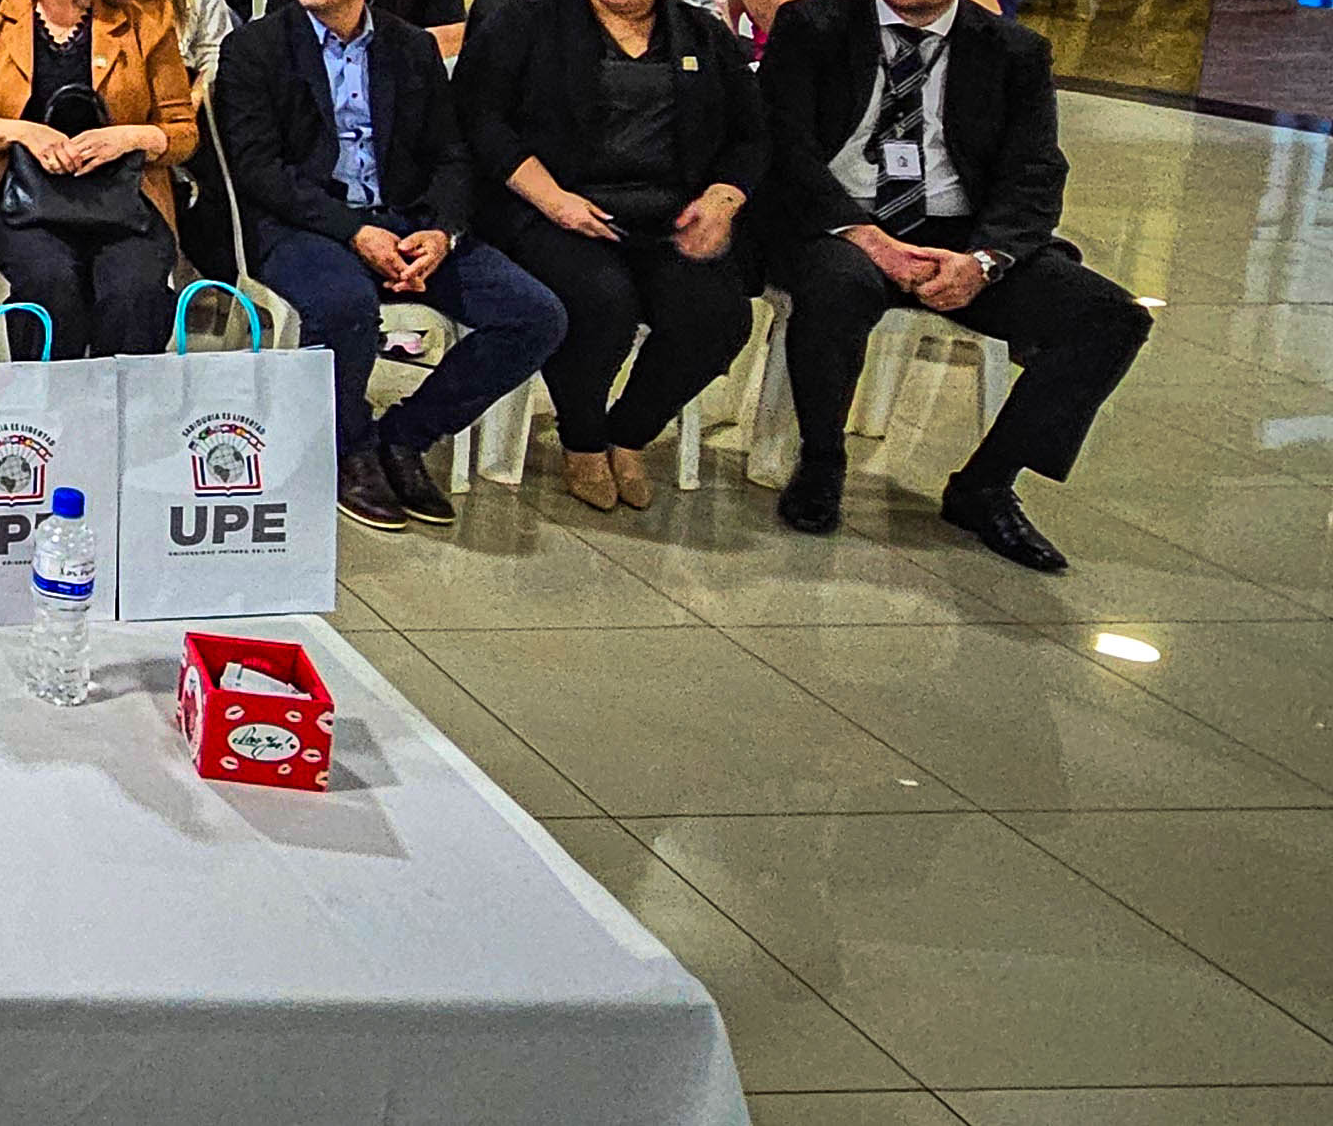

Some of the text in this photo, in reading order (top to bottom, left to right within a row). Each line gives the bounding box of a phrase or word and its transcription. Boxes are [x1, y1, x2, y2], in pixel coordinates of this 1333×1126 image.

[11, 423, 19, 431] ES
[21, 424, 56, 447] LIBERTAD
[222, 412, 231, 421] ES
[233, 413, 266, 435] LIBERTAD
[170, 503, 287, 546] UPE
